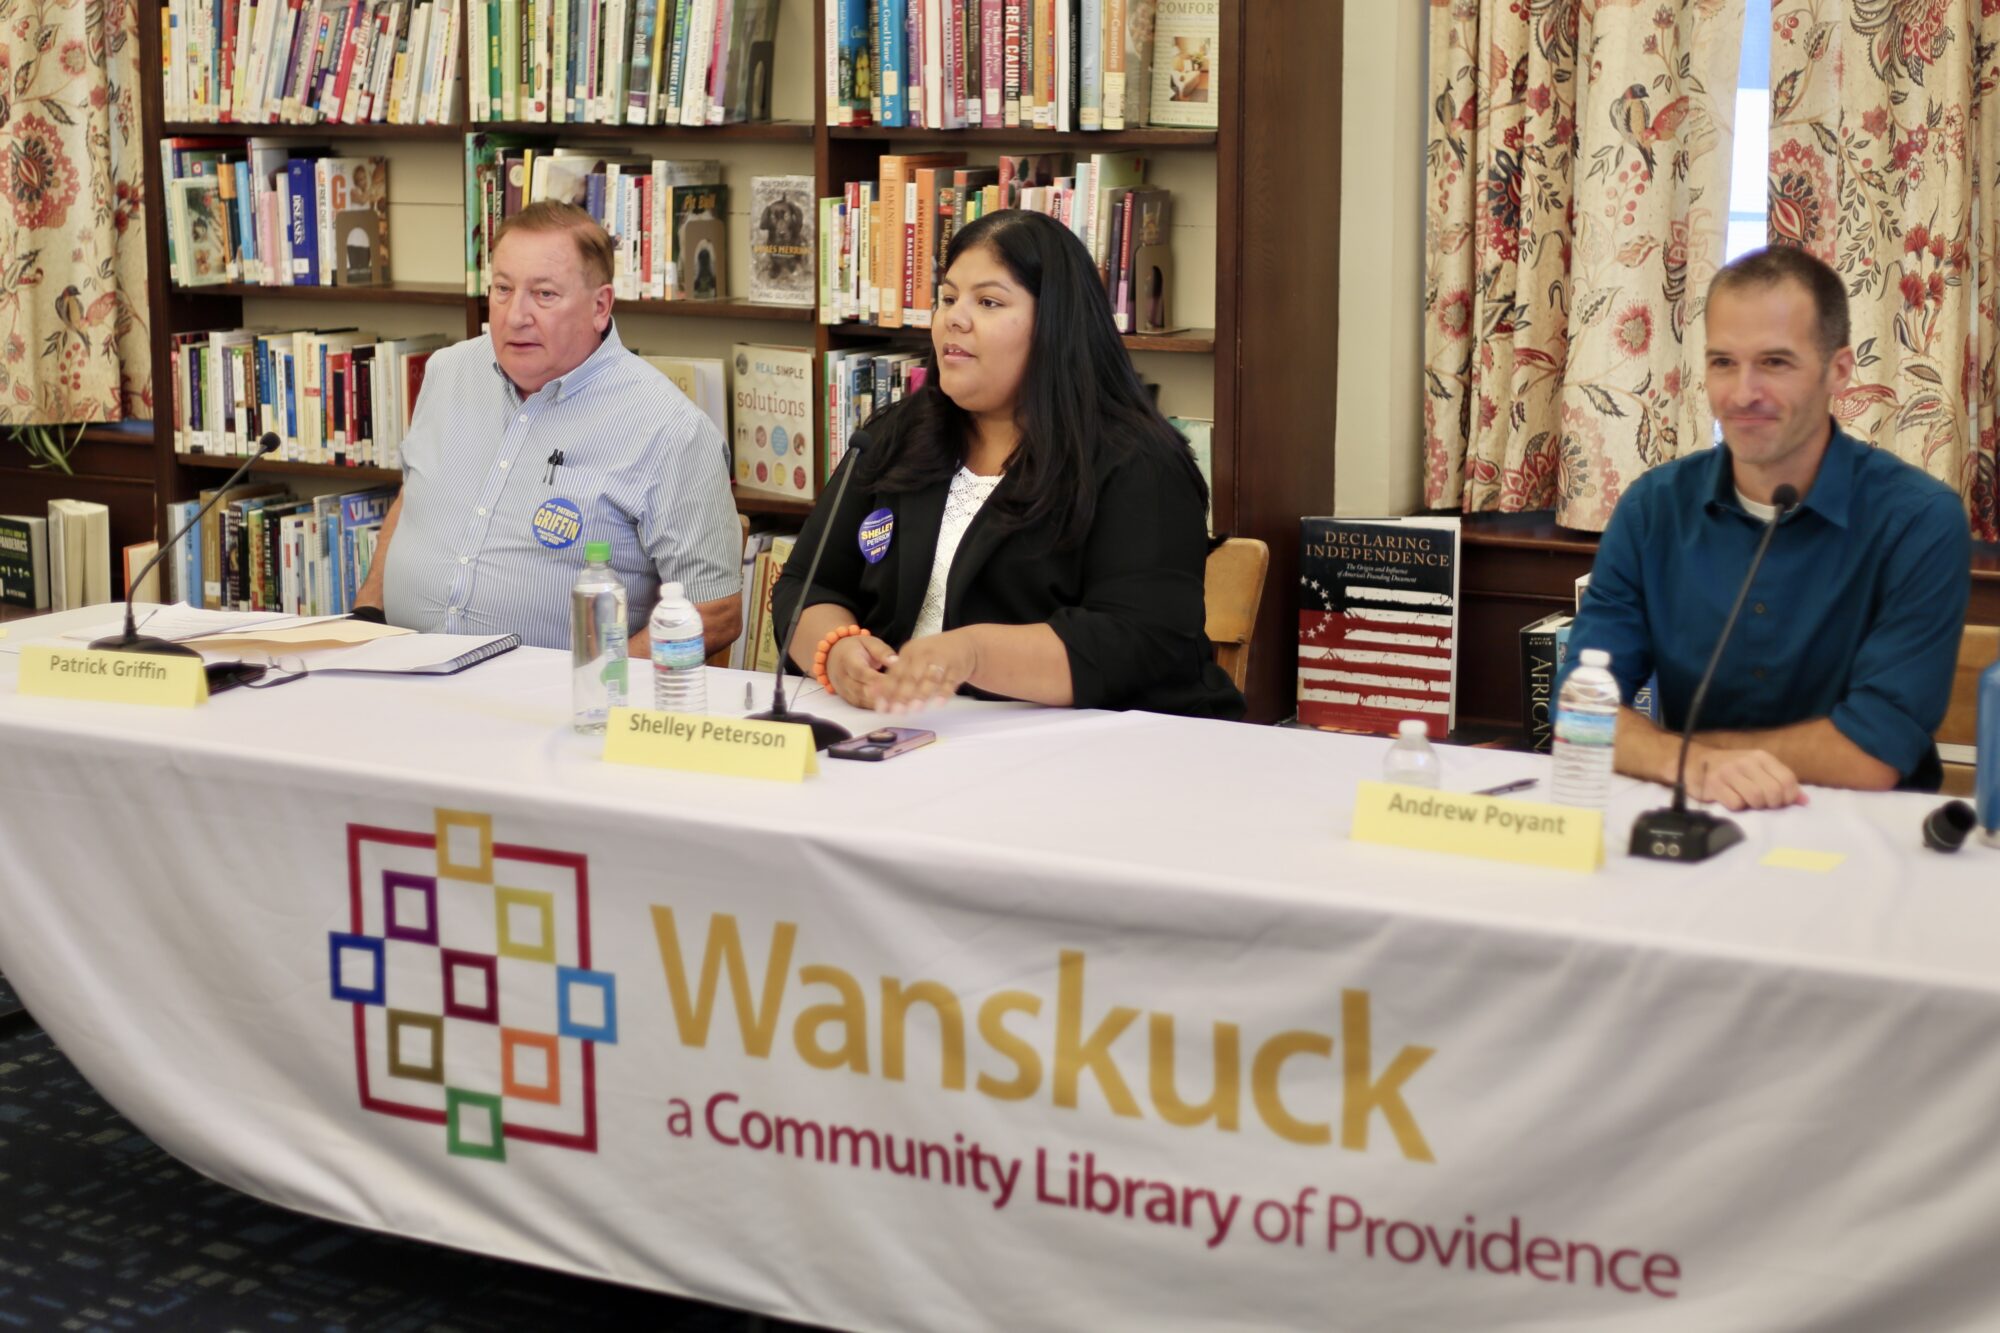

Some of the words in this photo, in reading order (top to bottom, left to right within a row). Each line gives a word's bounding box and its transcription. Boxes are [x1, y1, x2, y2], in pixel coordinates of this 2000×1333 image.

[883, 9, 892, 34] Good
[993, 9, 1001, 24] The
[1005, 5, 1020, 40] REAL
[884, 36, 893, 61] Home
[982, 27, 992, 60] England
[992, 26, 1001, 45] Book
[1110, 19, 1121, 69] Casseroles
[670, 55, 681, 85] PERFECT
[984, 61, 993, 89] Cooker
[1005, 45, 1020, 87] CAJUN
[886, 185, 897, 227] BAKING
[885, 230, 896, 288] ILLUSTRAT
[906, 237, 914, 275] BAKER'S
[736, 388, 806, 418] solutions
[534, 507, 581, 541] GRIFFIN
[556, 505, 580, 521] PATRICK
[861, 520, 894, 541] SHELLEY
[1324, 530, 1431, 551] DECLARING
[1306, 544, 1450, 567] INDEPENDENCE
[1346, 562, 1356, 570] The
[1356, 564, 1374, 574] Origin
[1375, 565, 1385, 573] and
[1385, 566, 1409, 575] Influence
[1342, 571, 1366, 579] America's
[1366, 573, 1391, 582] Founding
[1391, 575, 1417, 584] Document
[49, 655, 108, 676] Patrick
[112, 660, 168, 680] Griffin
[629, 713, 696, 742] Shelley
[701, 721, 786, 748] Peterson
[1387, 791, 1477, 824] Andrew
[1484, 804, 1567, 836] Poyant
[651, 906, 1433, 1162] Wanskuck
[668, 1098, 693, 1137] a
[704, 1093, 1022, 1209] Community
[1036, 1149, 1240, 1249] Library
[1253, 1187, 1315, 1246] of
[1327, 1196, 1681, 1299] Providence
